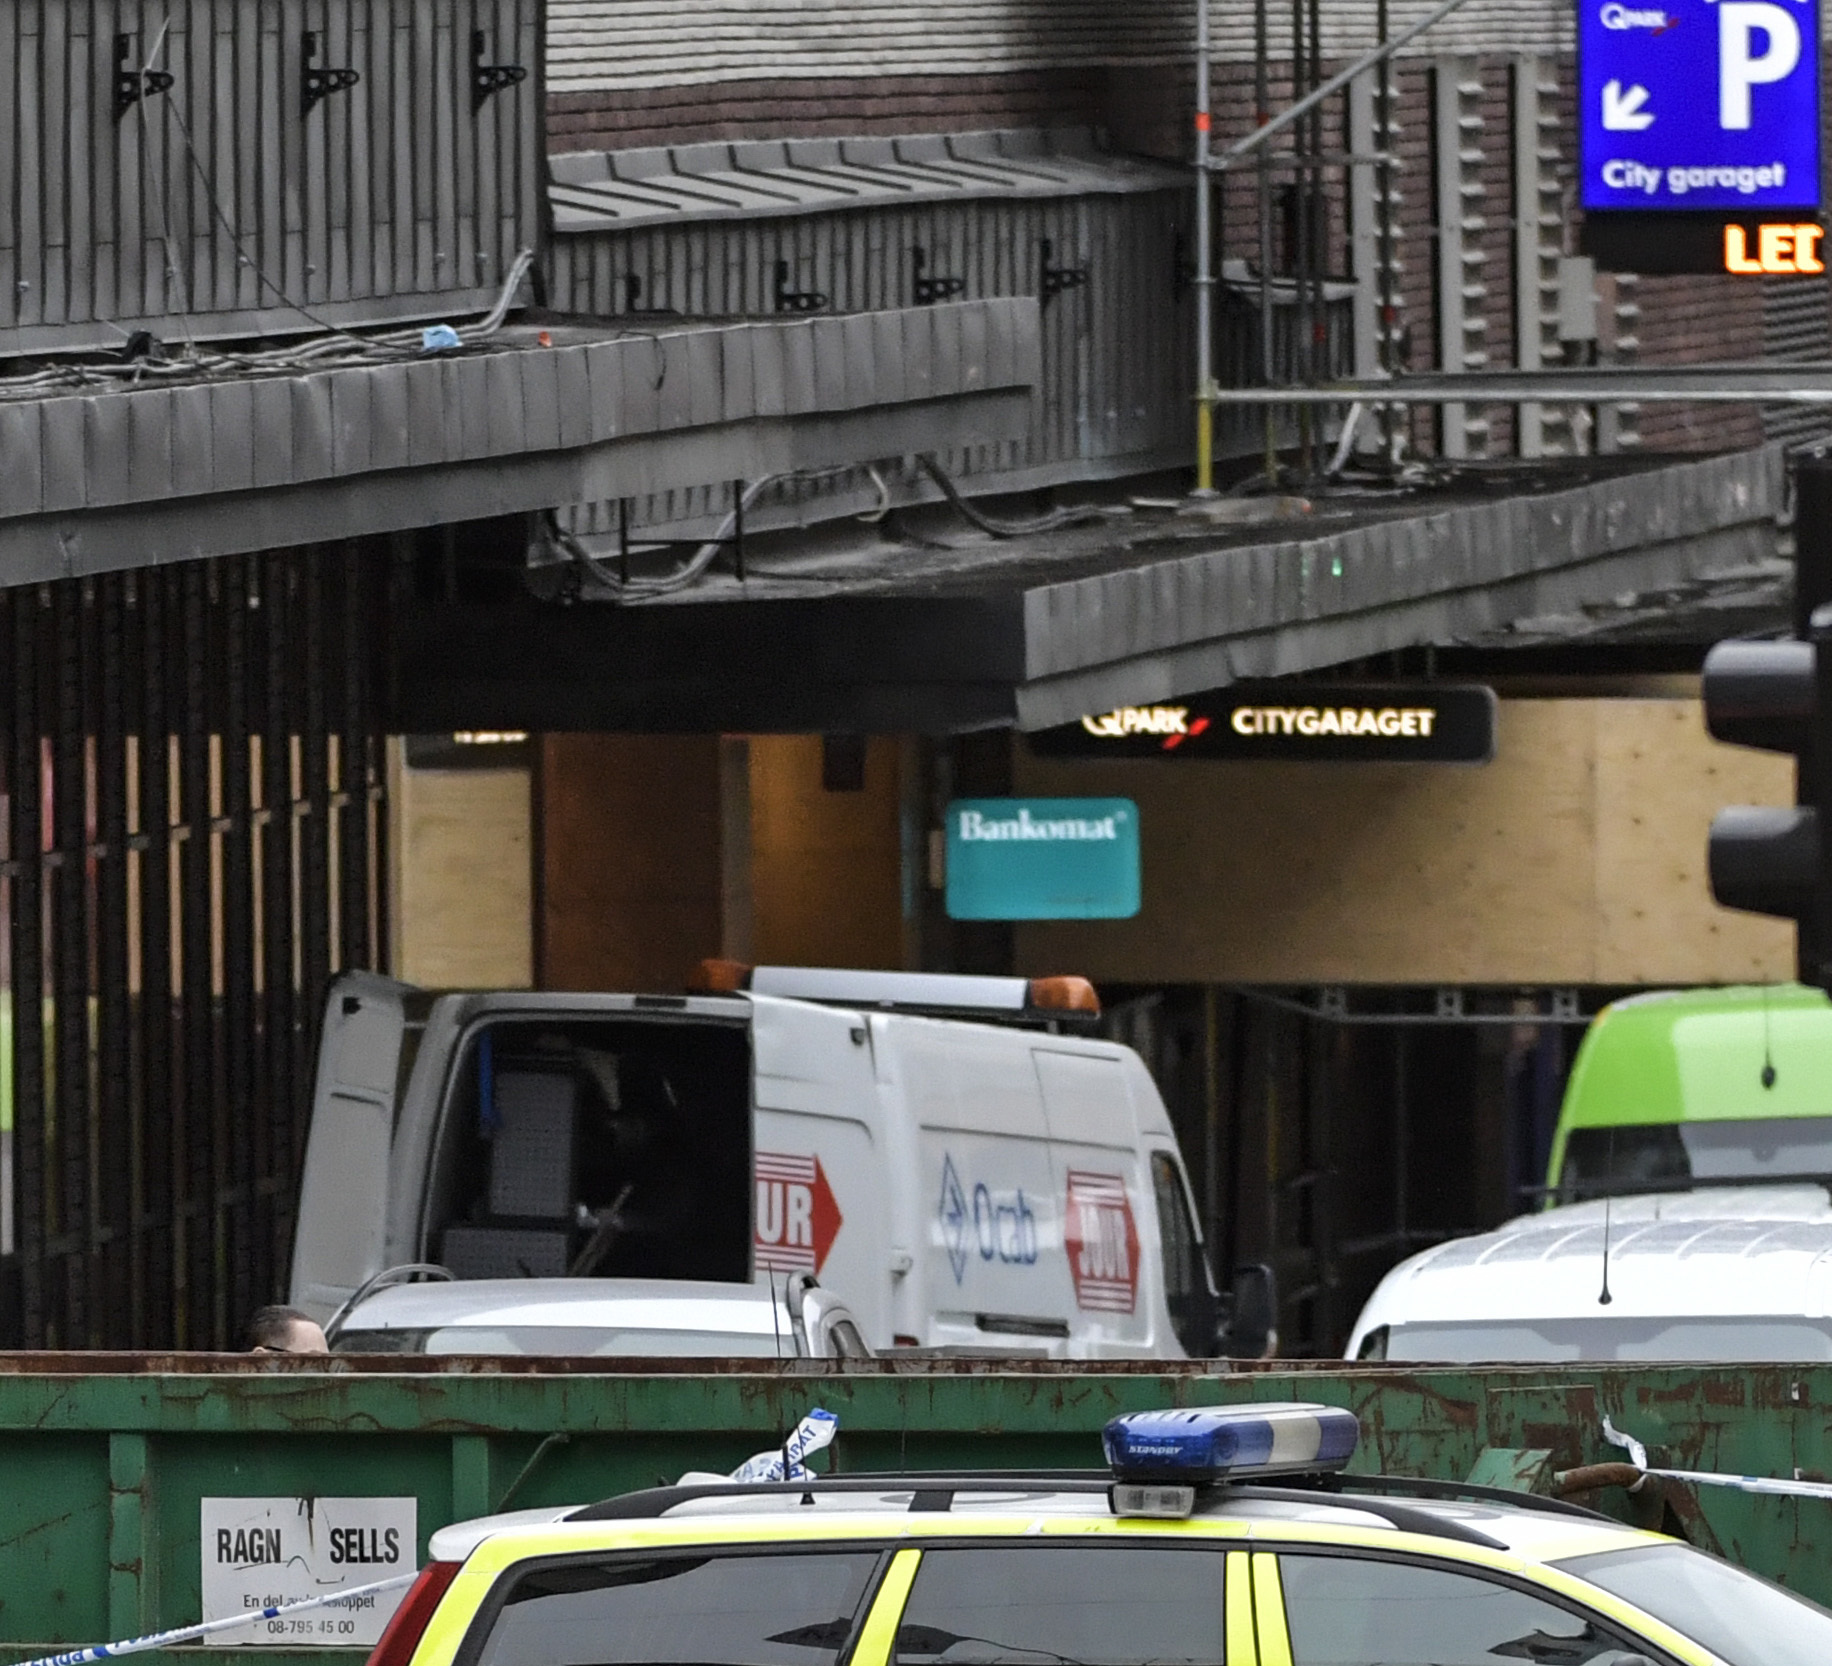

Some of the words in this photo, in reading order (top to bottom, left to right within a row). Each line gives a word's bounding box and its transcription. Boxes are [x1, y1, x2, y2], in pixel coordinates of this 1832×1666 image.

[1719, 2, 1802, 130] P
[1601, 159, 1662, 194] City
[1667, 161, 1786, 194] garaget
[1232, 706, 1436, 737] CITYGARAGET
[959, 808, 1117, 841] Bankomat
[217, 1527, 282, 1564] RAGN
[329, 1526, 400, 1564] SELLS
[243, 1594, 260, 1609] En
[263, 1594, 283, 1608] del
[267, 1620, 313, 1634] 08-795
[318, 1620, 334, 1634] 45
[338, 1620, 355, 1634] 00
